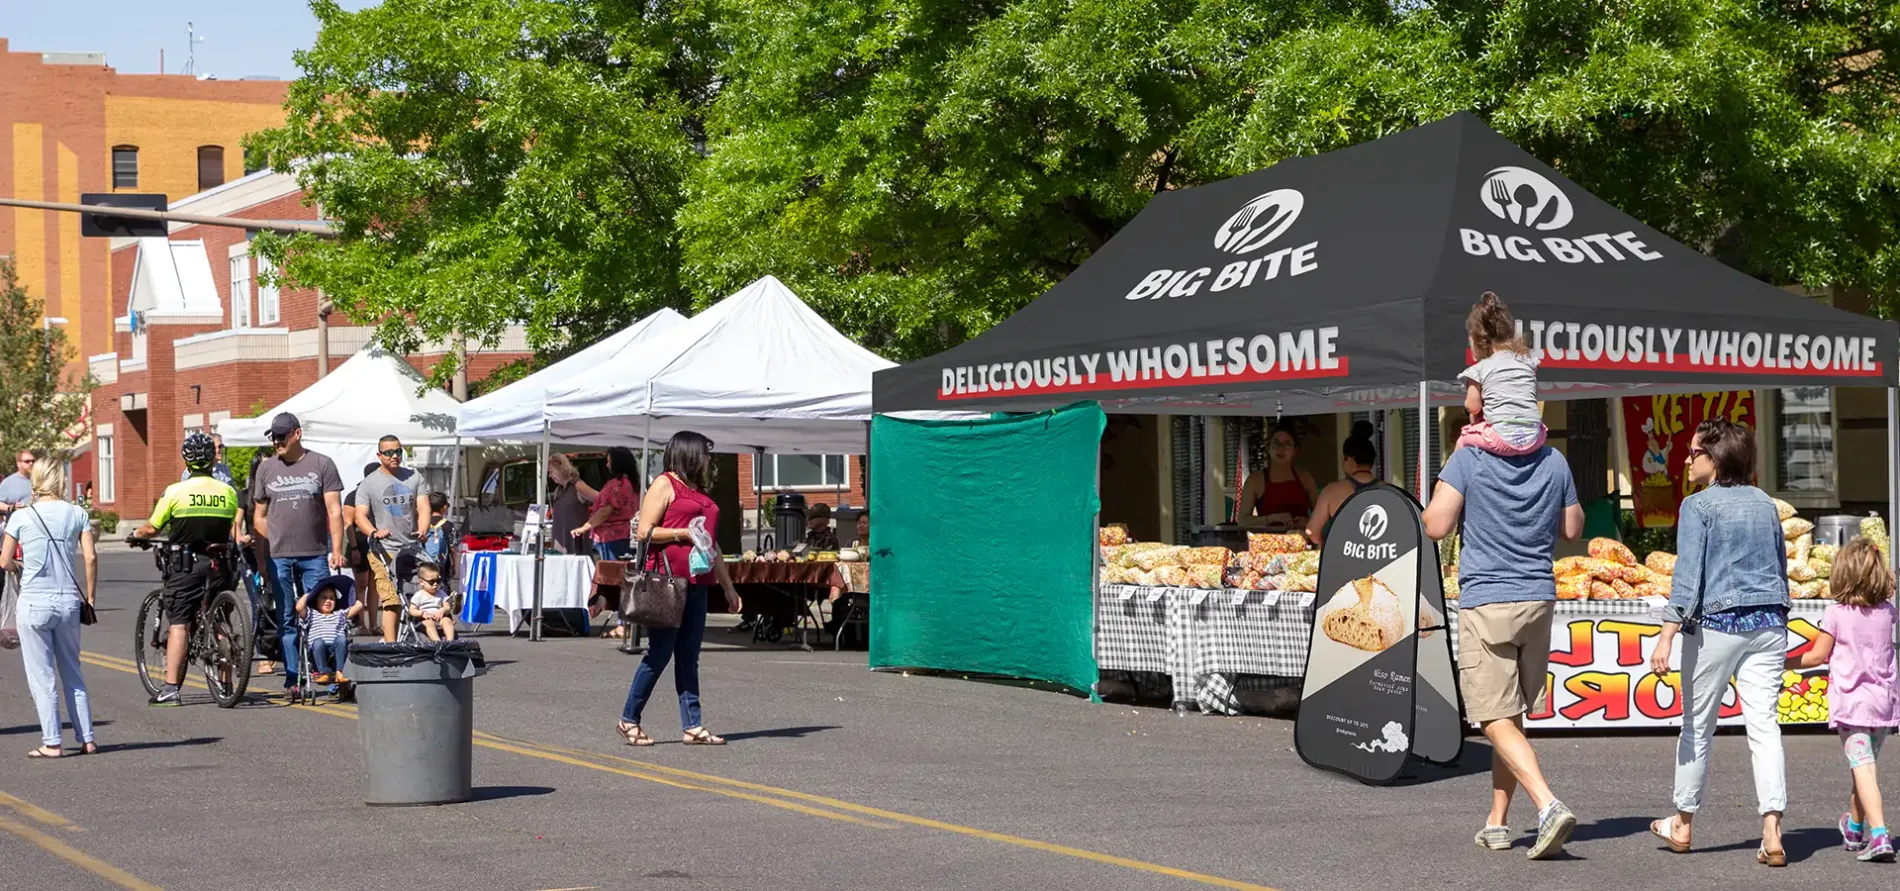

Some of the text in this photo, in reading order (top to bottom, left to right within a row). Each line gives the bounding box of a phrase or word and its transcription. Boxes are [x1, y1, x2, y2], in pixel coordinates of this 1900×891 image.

[1459, 228, 1664, 265] BIG BITE
[1125, 241, 1319, 301] BIG BITE
[941, 326, 1341, 397] DELICIOUSLY WHOLESOME
[1687, 329, 1877, 371] WHOLESOME
[1343, 541, 1398, 560] BIG BITE
[1326, 714, 1347, 723] DISCOUNT
